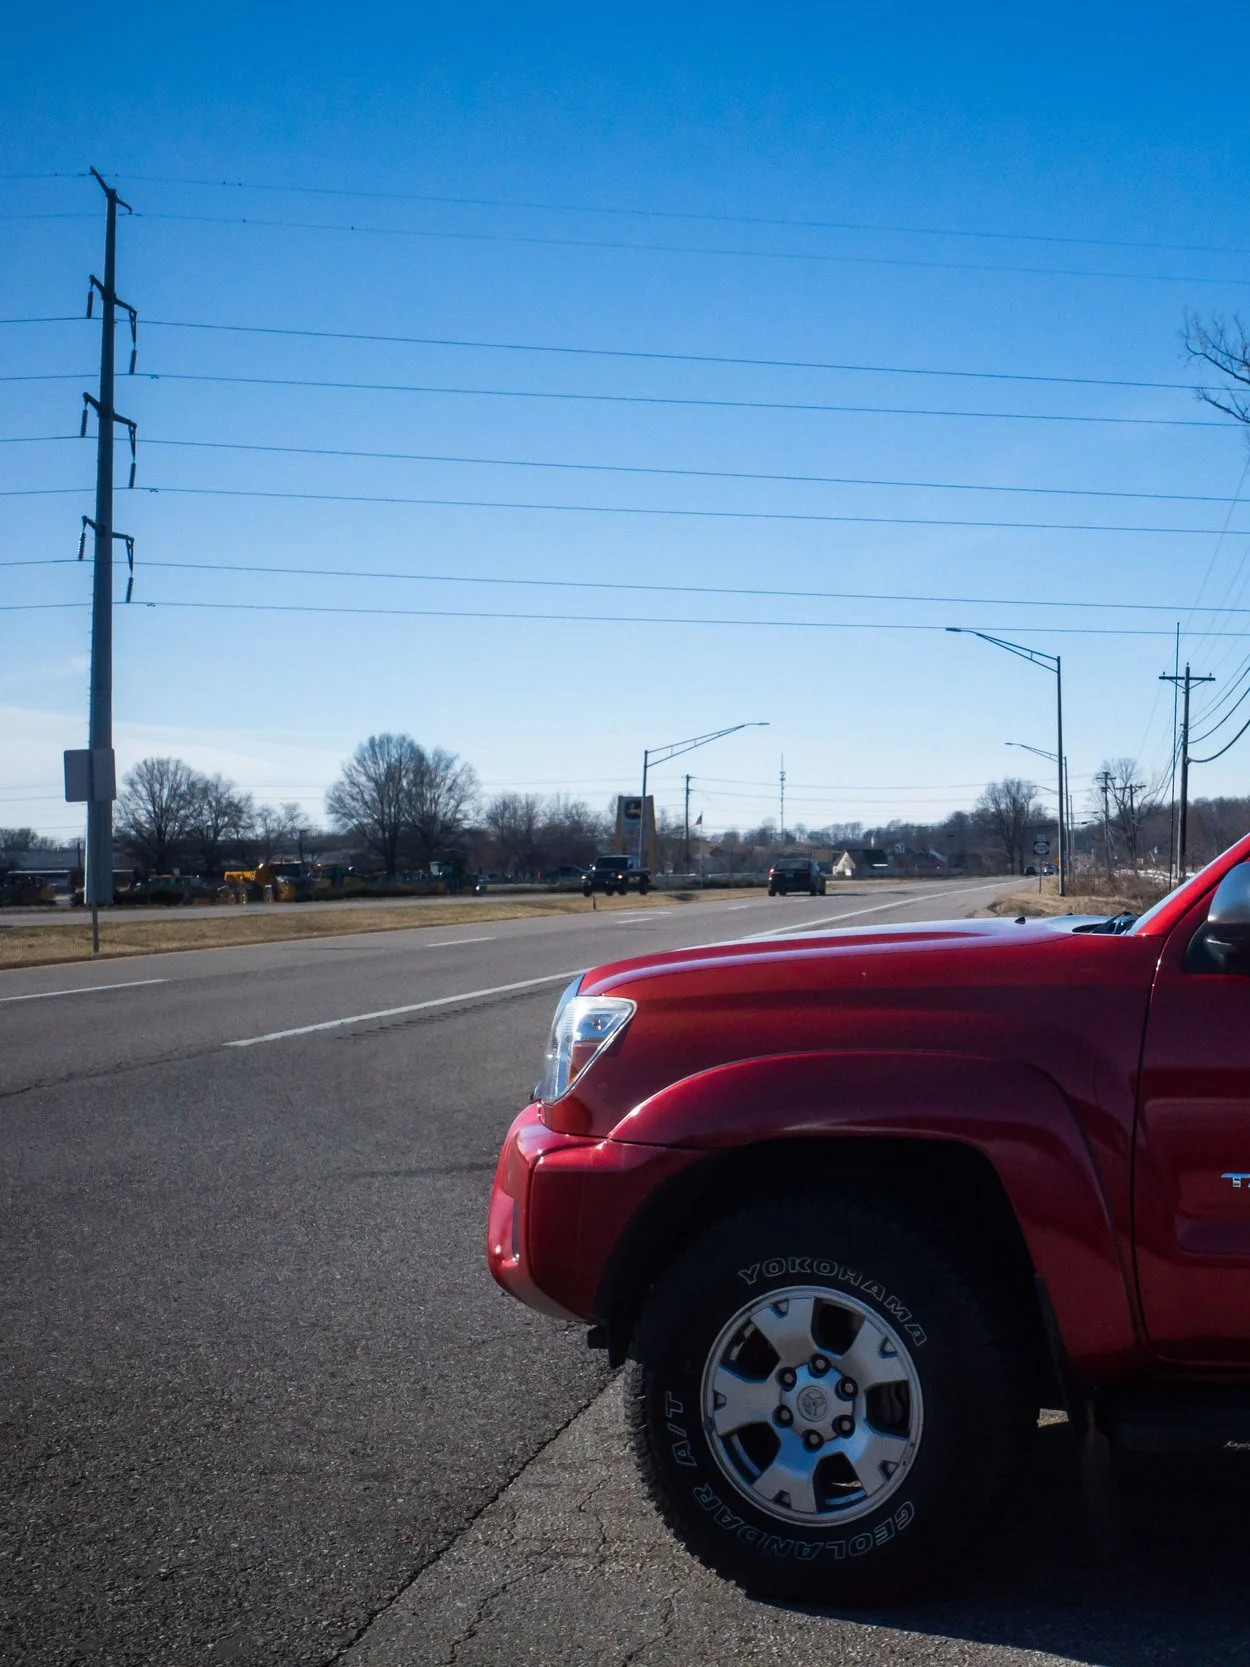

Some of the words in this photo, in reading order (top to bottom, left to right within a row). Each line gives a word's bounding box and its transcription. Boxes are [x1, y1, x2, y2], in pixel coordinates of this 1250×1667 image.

[737, 1256, 928, 1347] YOKOHAMA
[664, 1390, 697, 1468] A/T
[692, 1483, 915, 1560] GEOLANDAR
